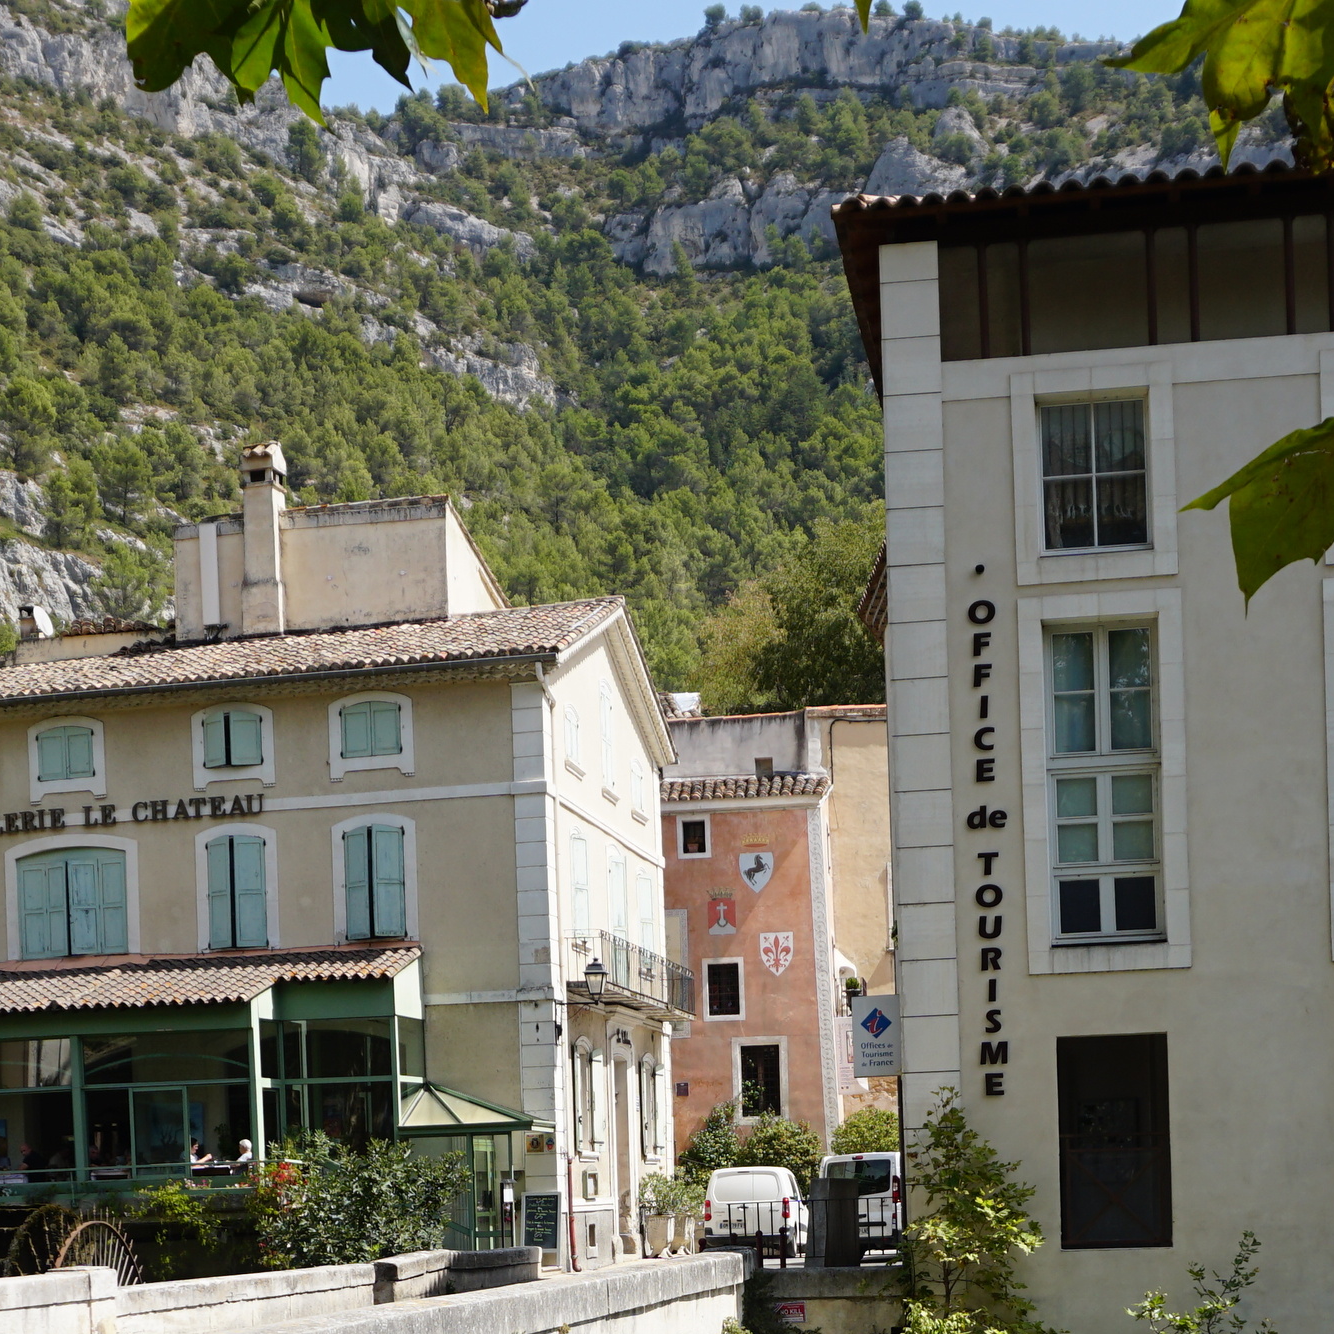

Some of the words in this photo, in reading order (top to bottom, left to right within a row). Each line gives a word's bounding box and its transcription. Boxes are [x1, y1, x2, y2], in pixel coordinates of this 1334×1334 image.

[967, 598, 996, 784] OFFICE
[82, 804, 117, 828] LE
[131, 793, 265, 823] CHATEAU
[966, 804, 1008, 831] de
[975, 850, 1009, 1098] TOURISME
